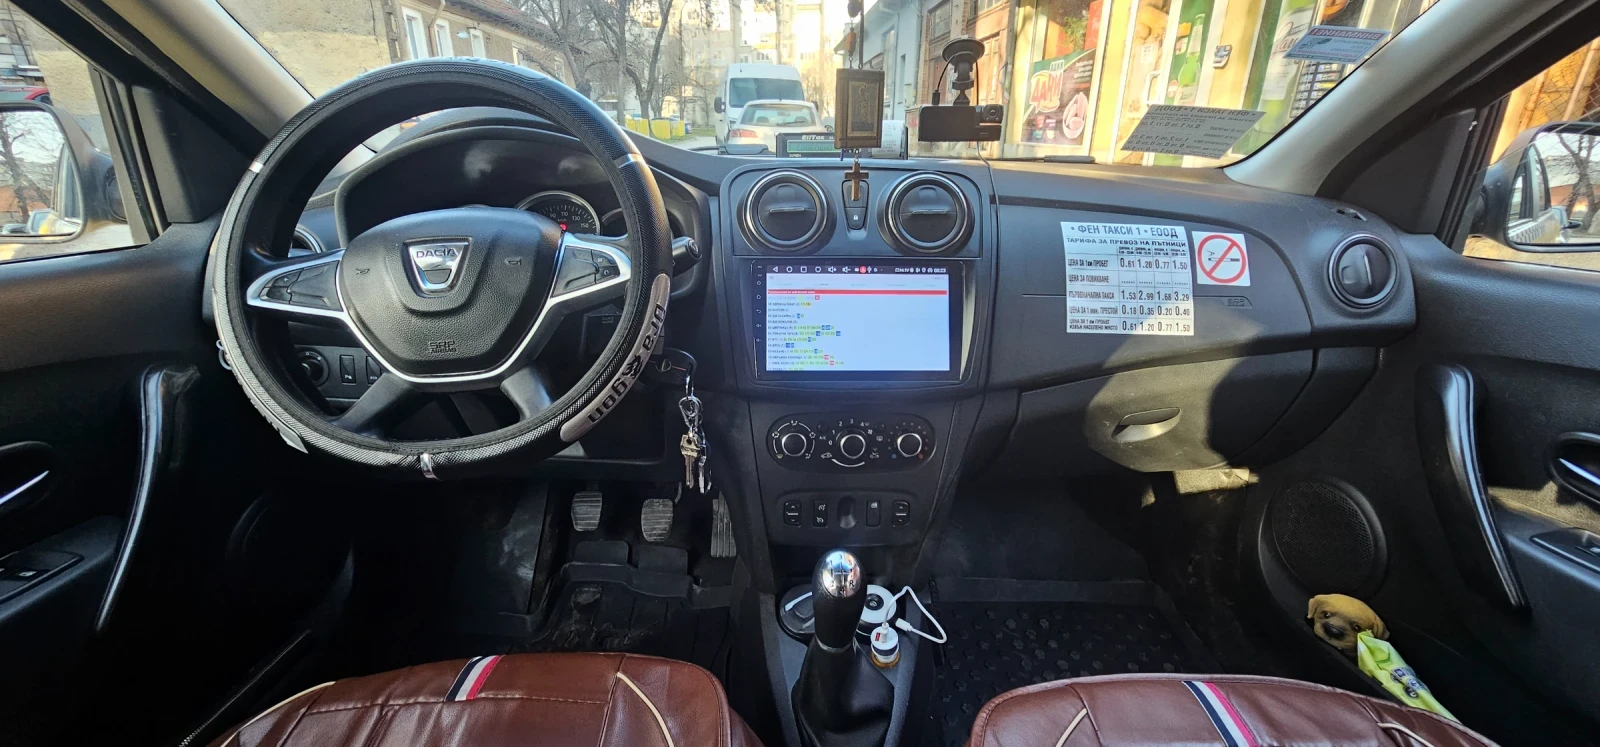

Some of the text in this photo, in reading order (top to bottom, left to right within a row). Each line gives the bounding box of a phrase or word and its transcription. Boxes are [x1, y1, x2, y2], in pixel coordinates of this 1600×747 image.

[1078, 224, 1178, 238] ФЕН ТАКСИ 1 ЕООД
[416, 248, 458, 258] DACIA
[1094, 260, 1108, 268] ПРОБЕГ
[1120, 258, 1135, 268] 0.61
[1138, 258, 1152, 269] 1.20
[1155, 259, 1170, 269] 0.77
[1173, 260, 1187, 270] 1.50
[1121, 290, 1136, 300] 1.53
[1139, 290, 1153, 300] 2.99
[1157, 290, 1172, 300] 1.68
[1174, 291, 1189, 301] 3.29
[1122, 304, 1136, 315] 0.18
[1140, 305, 1154, 315] 0.35
[1157, 305, 1172, 315] 0.20
[1175, 306, 1190, 316] 0.40
[1122, 321, 1190, 332] 0.61 1.20 0.77 1.50
